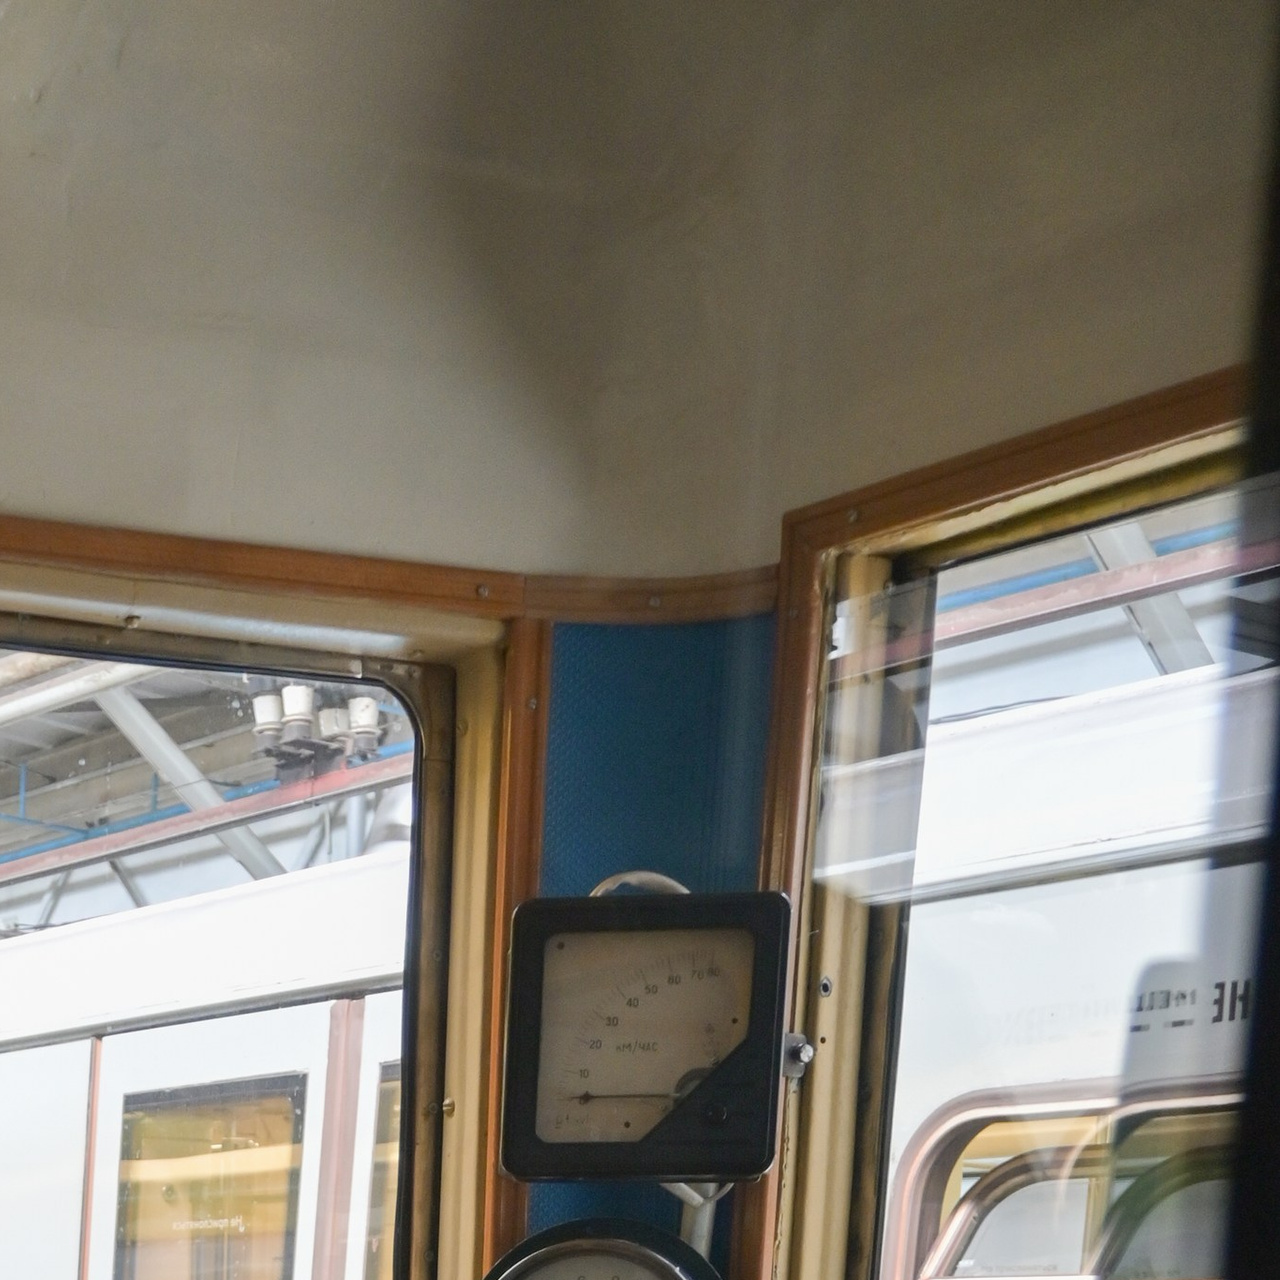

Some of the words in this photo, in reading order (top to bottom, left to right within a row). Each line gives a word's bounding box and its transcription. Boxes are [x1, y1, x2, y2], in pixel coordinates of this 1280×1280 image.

[645, 984, 658, 995] 50
[626, 997, 640, 1008] 40
[605, 1016, 619, 1027] 30
[589, 1039, 603, 1050] 20
[579, 1069, 590, 1079] 10
